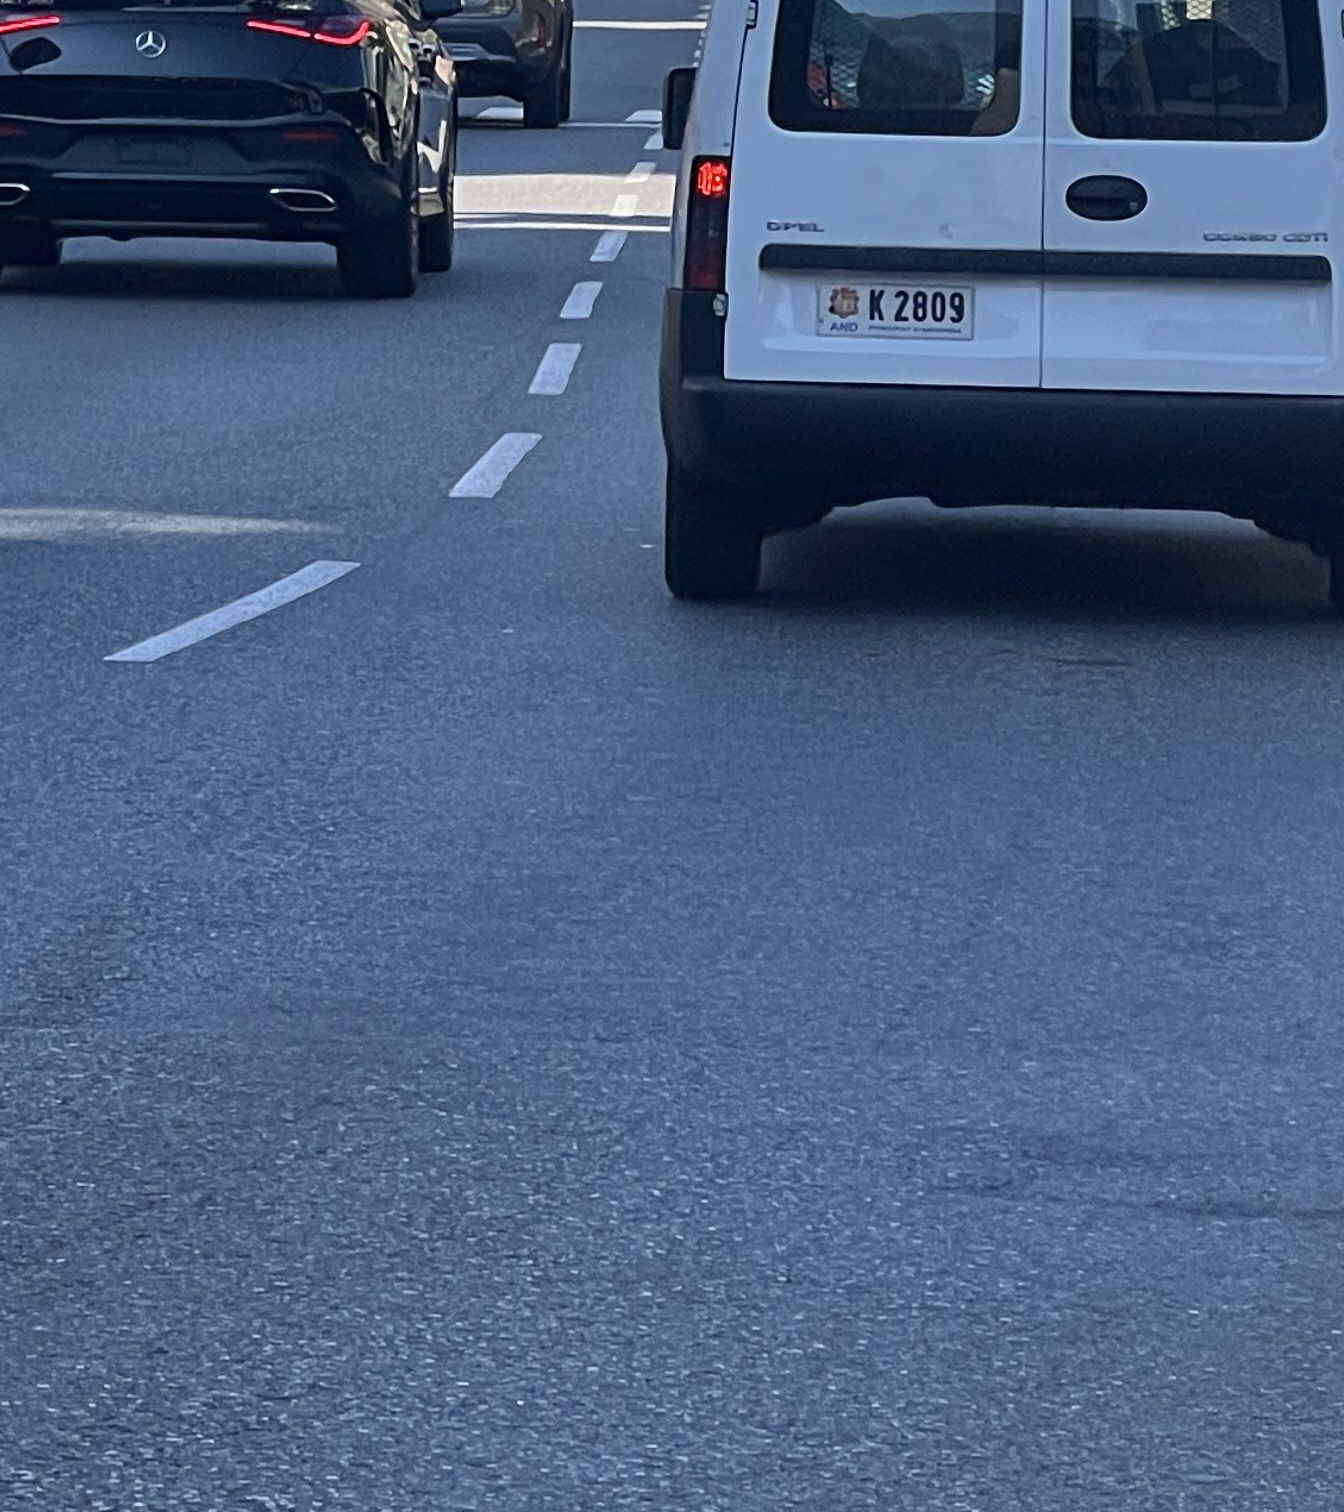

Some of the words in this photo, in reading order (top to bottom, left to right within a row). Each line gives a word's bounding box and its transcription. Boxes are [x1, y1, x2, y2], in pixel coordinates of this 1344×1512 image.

[766, 221, 825, 233] OPEL
[868, 289, 885, 322] K
[893, 290, 964, 324] 2809
[829, 321, 859, 333] AND
